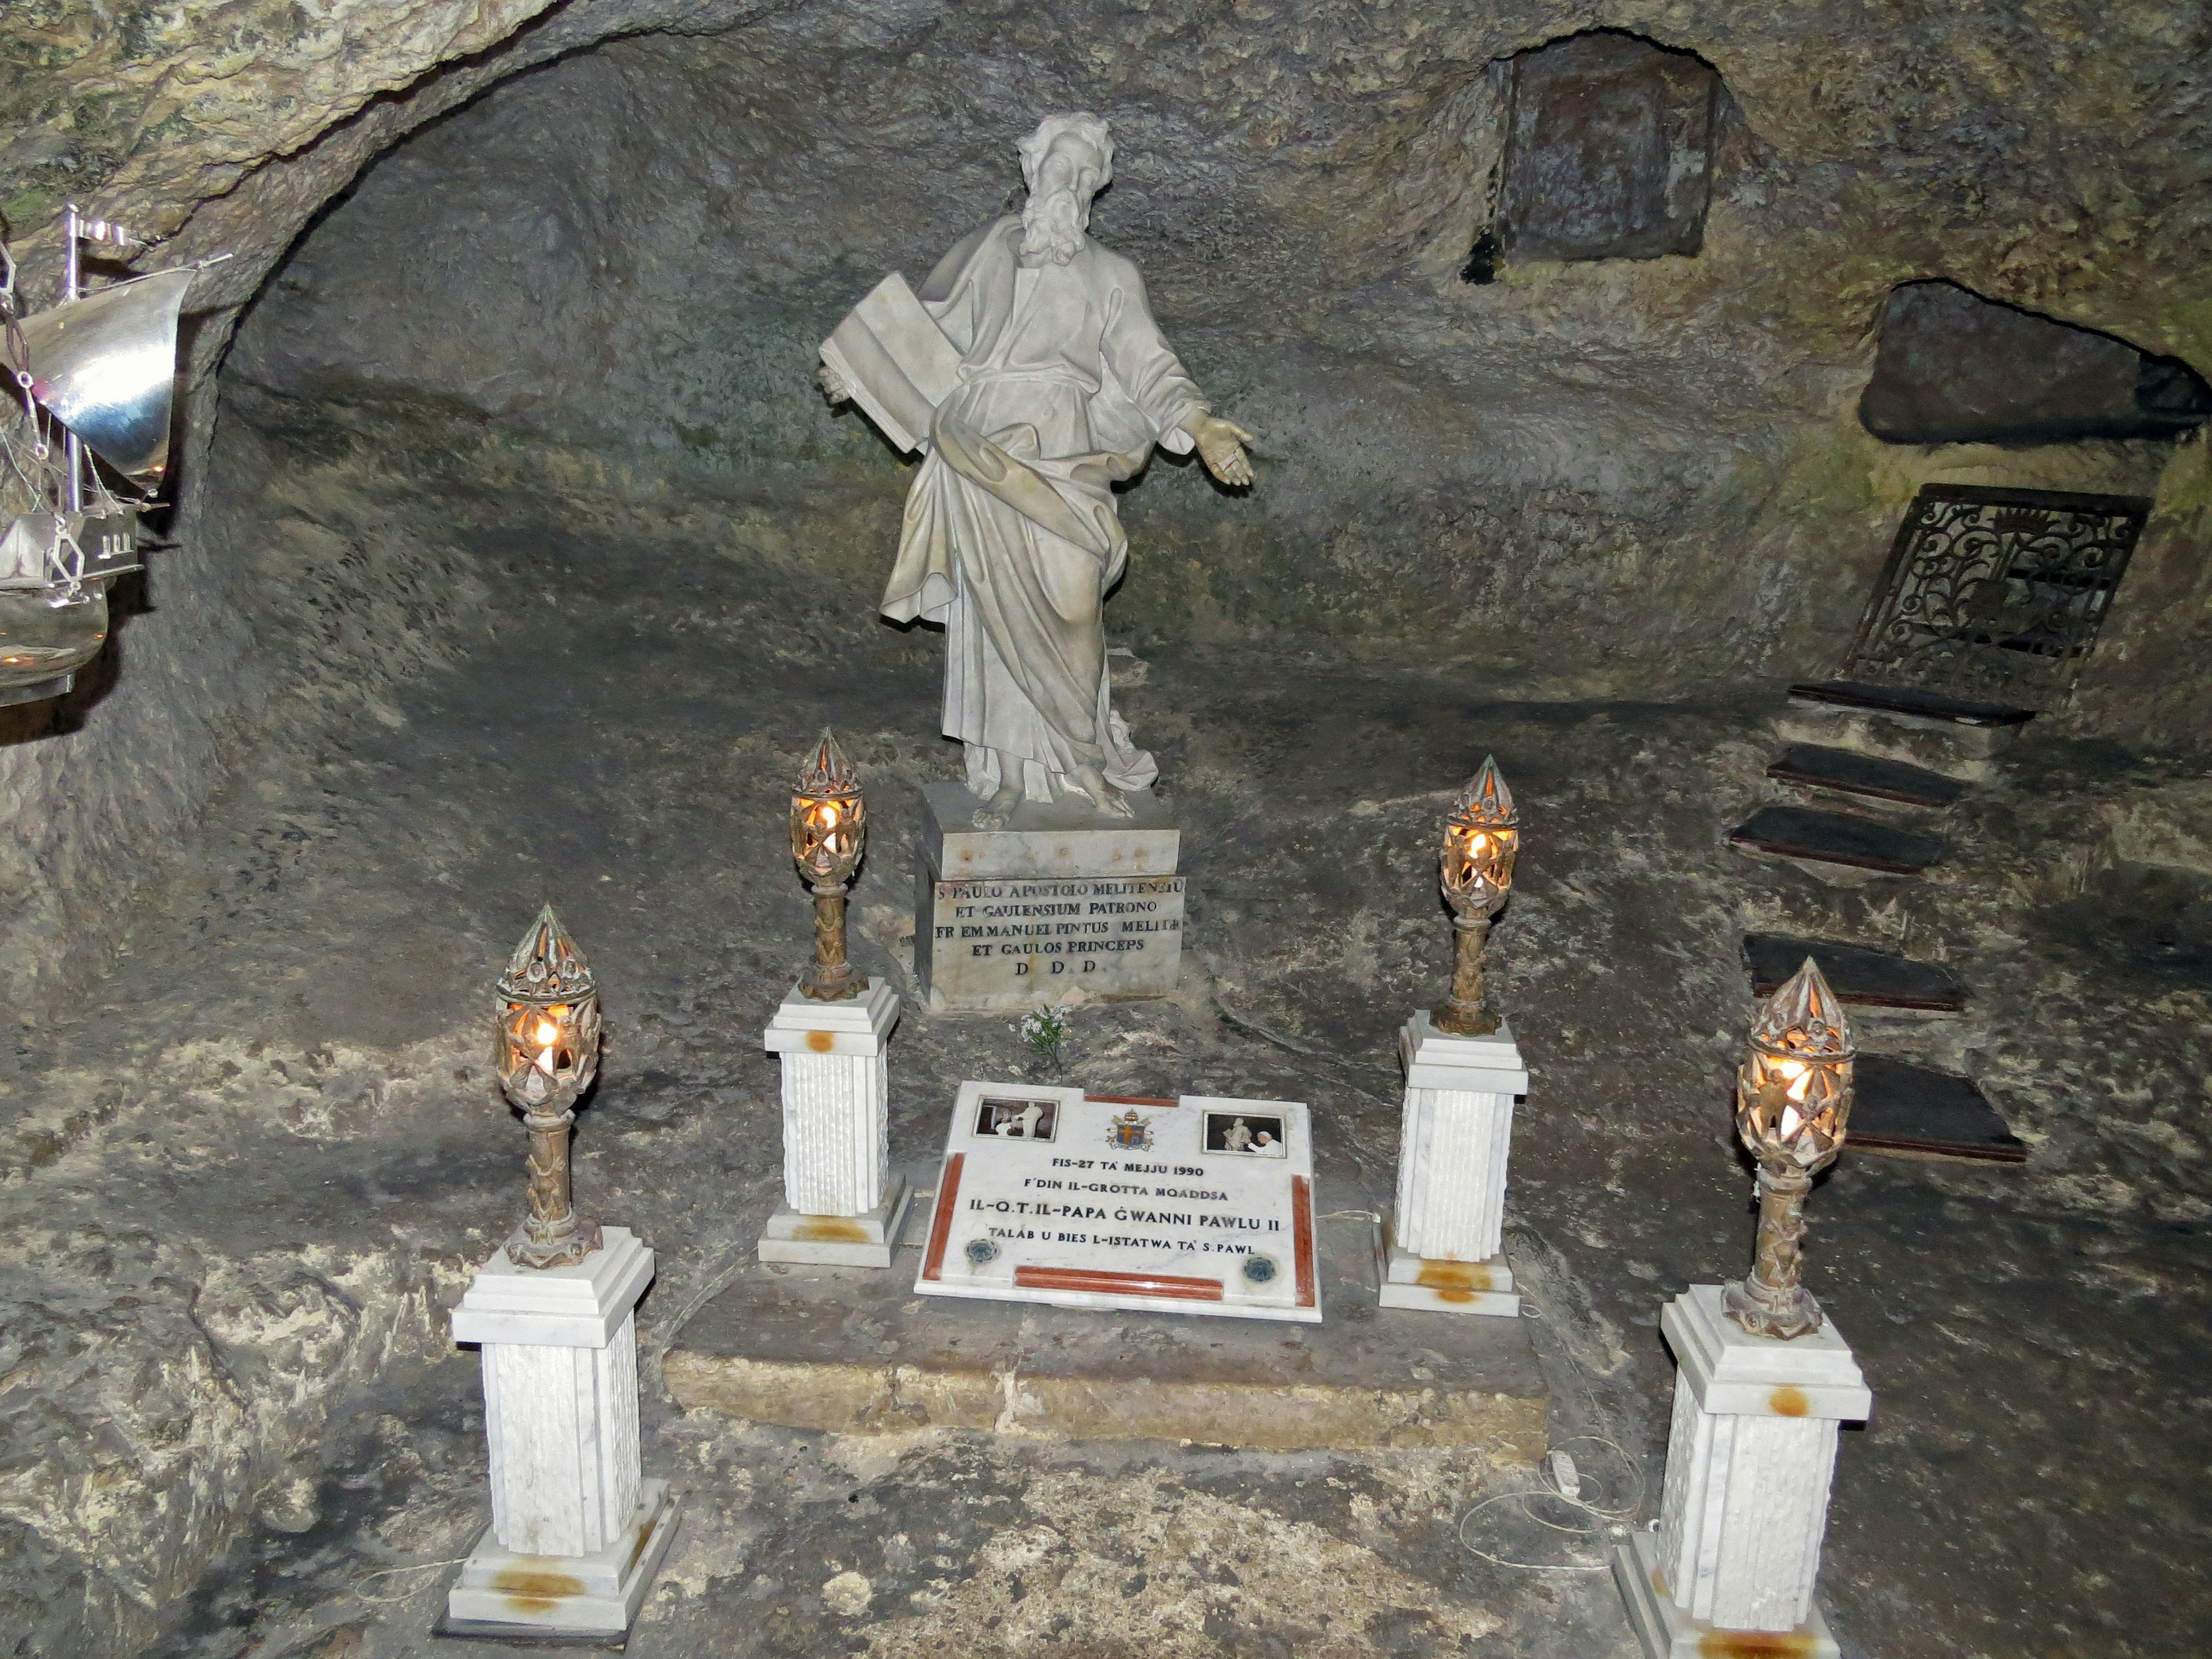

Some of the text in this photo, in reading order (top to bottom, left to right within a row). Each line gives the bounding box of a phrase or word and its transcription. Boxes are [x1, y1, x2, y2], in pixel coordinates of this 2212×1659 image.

[952, 885, 1003, 899] PAULO
[955, 900, 1157, 918] ET GAULENSIUM PATRONO
[935, 926, 955, 938] FR
[961, 923, 1051, 938] EMMANUEL
[1056, 922, 1109, 934] PINTUS
[971, 940, 1145, 956] ET GAULOS PRINCEPS
[1052, 1158, 1094, 1169] FIS-27
[1123, 1163, 1168, 1173] MEJJU
[1173, 1166, 1205, 1176] 1990
[1068, 1181, 1148, 1195] IL-GROTTA
[1155, 1188, 1228, 1201] MQADDSA
[1199, 1214, 1260, 1230] PAWLU
[1268, 1219, 1279, 1232] II
[1041, 1231, 1051, 1240] U
[1058, 1233, 1087, 1243] BIES
[1093, 1235, 1172, 1249] L-ISTATWA
